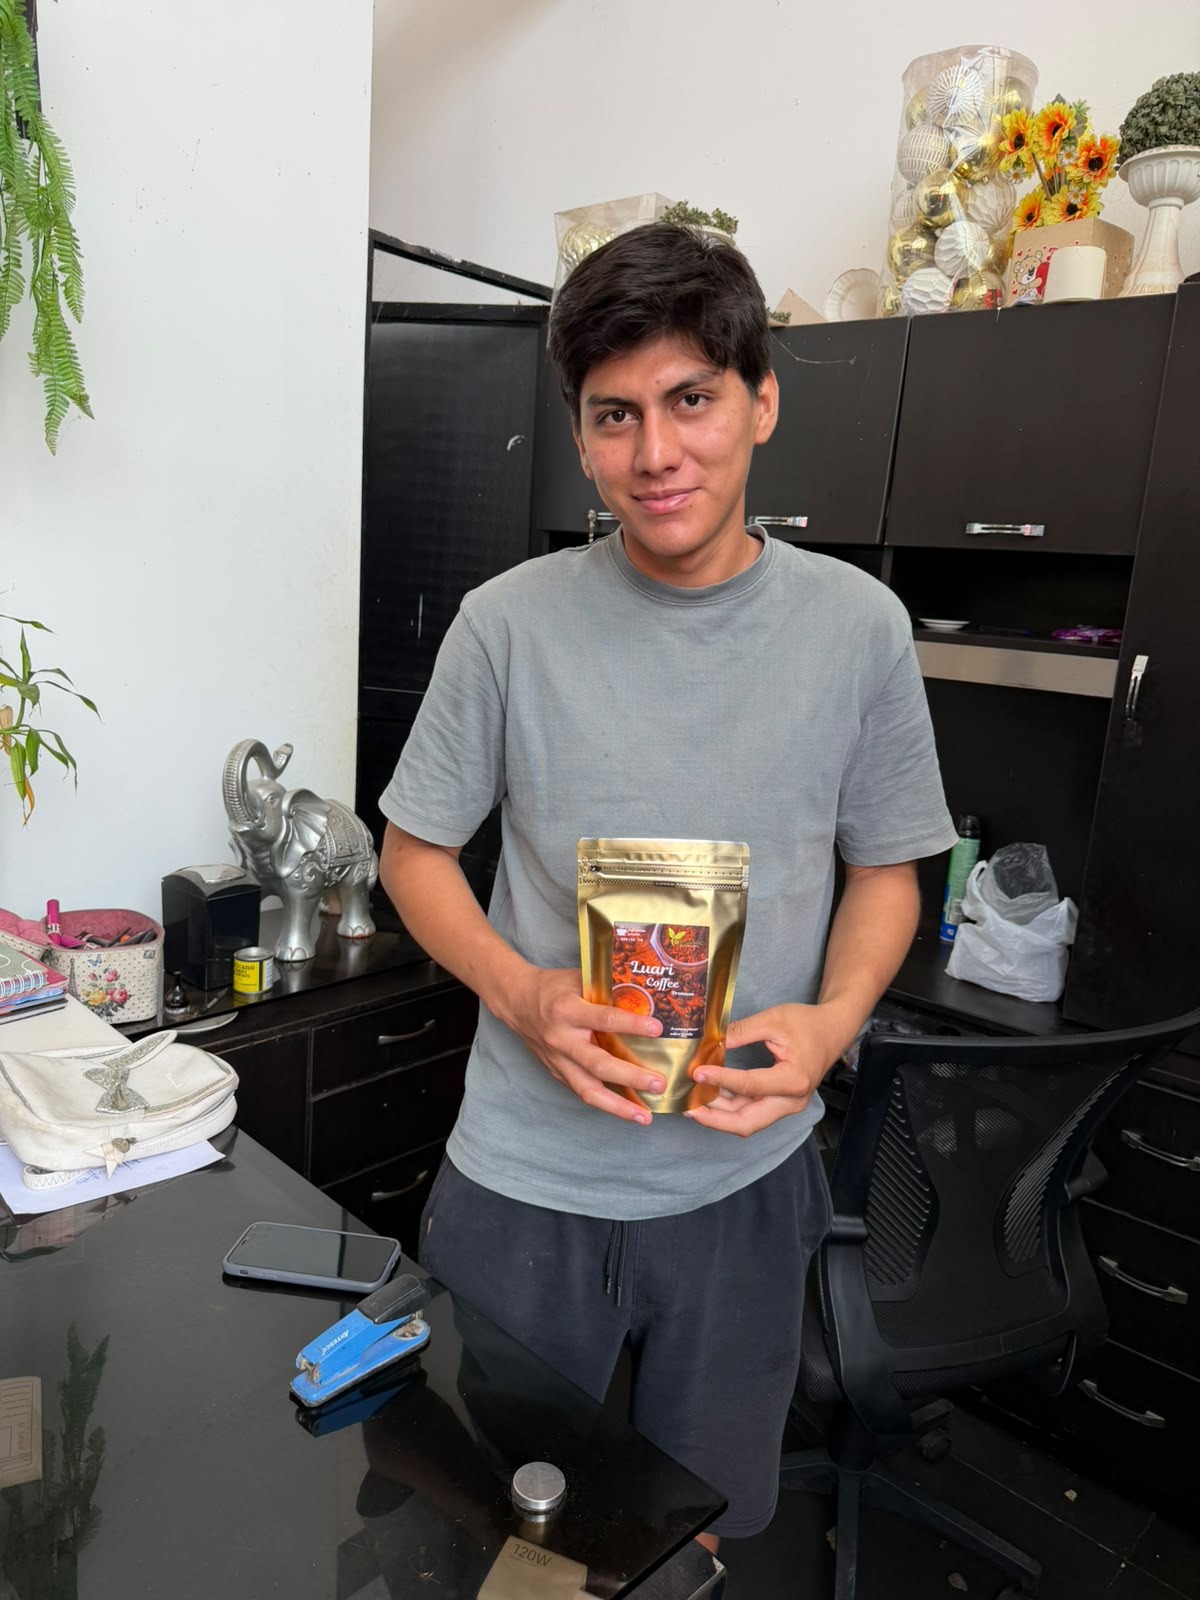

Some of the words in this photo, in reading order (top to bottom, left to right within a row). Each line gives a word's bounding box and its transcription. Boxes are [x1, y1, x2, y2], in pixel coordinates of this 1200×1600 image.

[630, 960, 675, 976] Luari
[646, 977, 680, 991] Coffee
[512, 1543, 552, 1567] 120W
